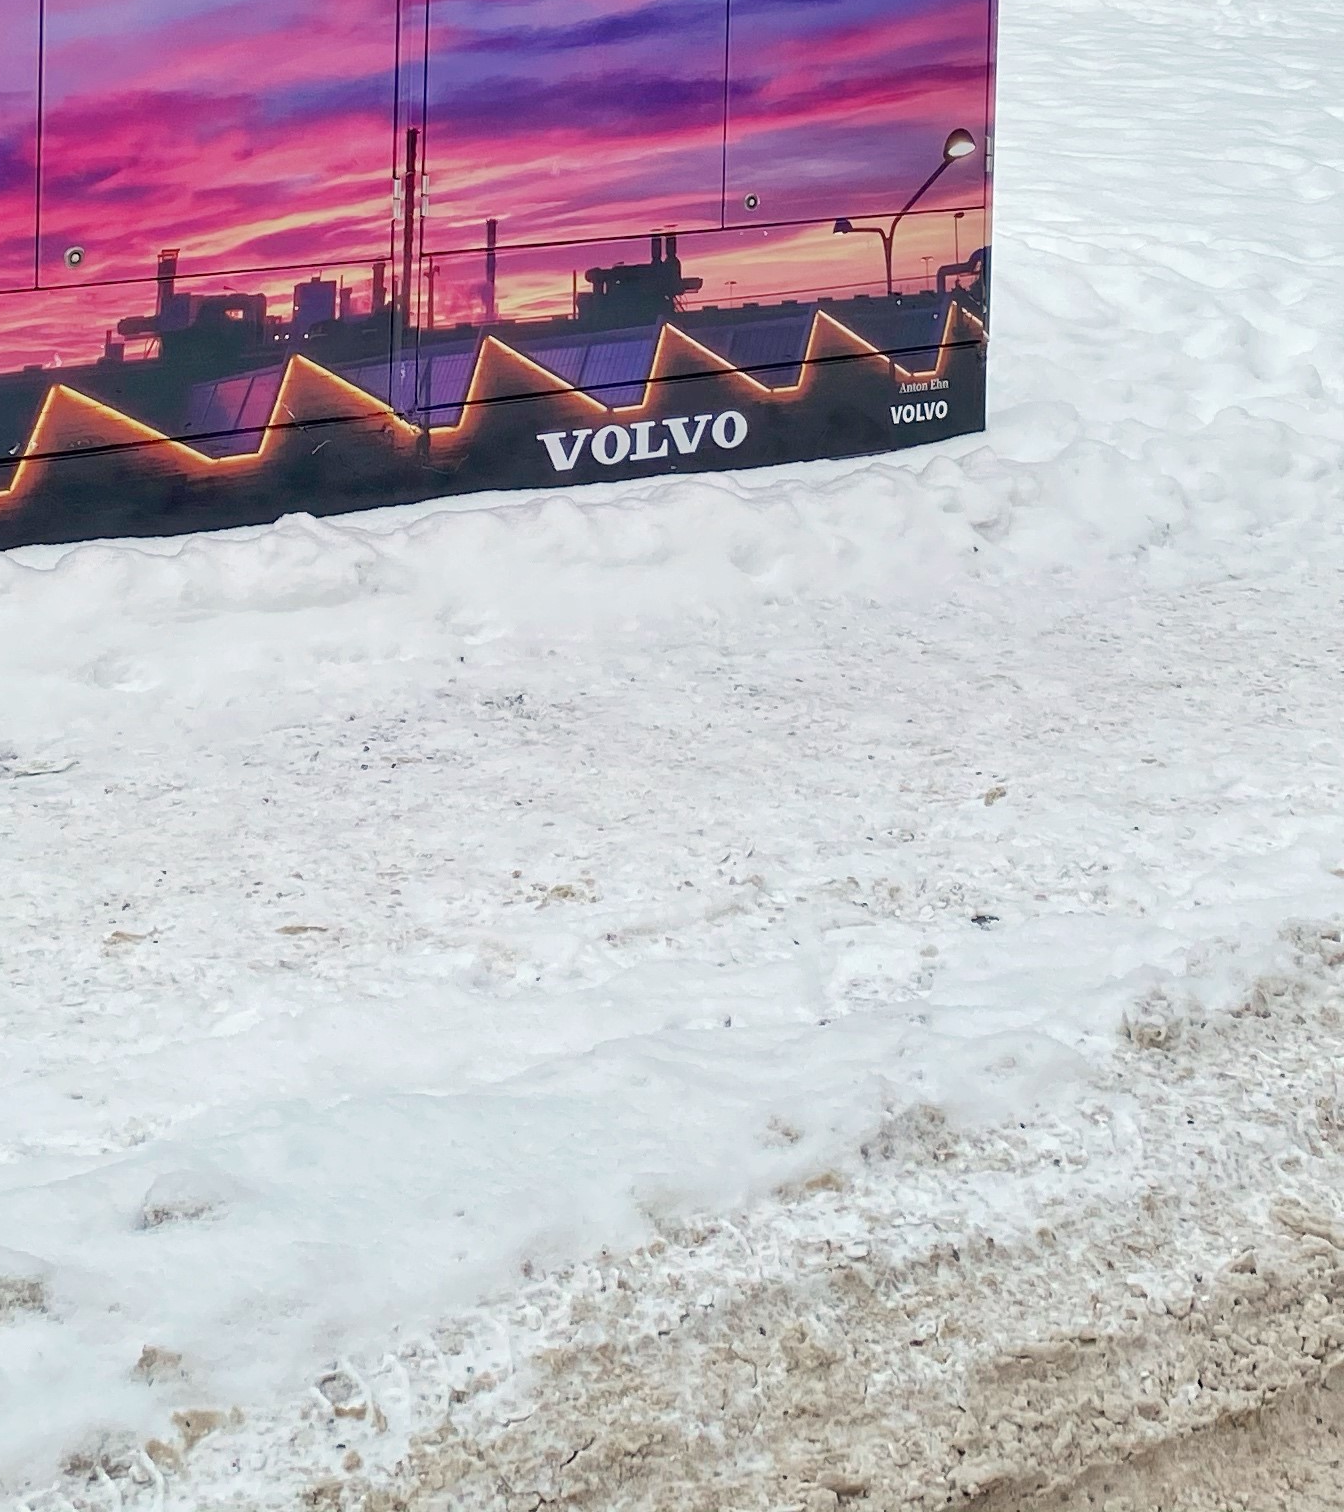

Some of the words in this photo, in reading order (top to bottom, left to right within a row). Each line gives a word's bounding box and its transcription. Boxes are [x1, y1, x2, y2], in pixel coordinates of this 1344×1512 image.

[899, 382, 928, 394] Anton
[930, 378, 949, 390] Ehn
[890, 400, 948, 425] VOLVO
[537, 410, 748, 471] VOLVO
